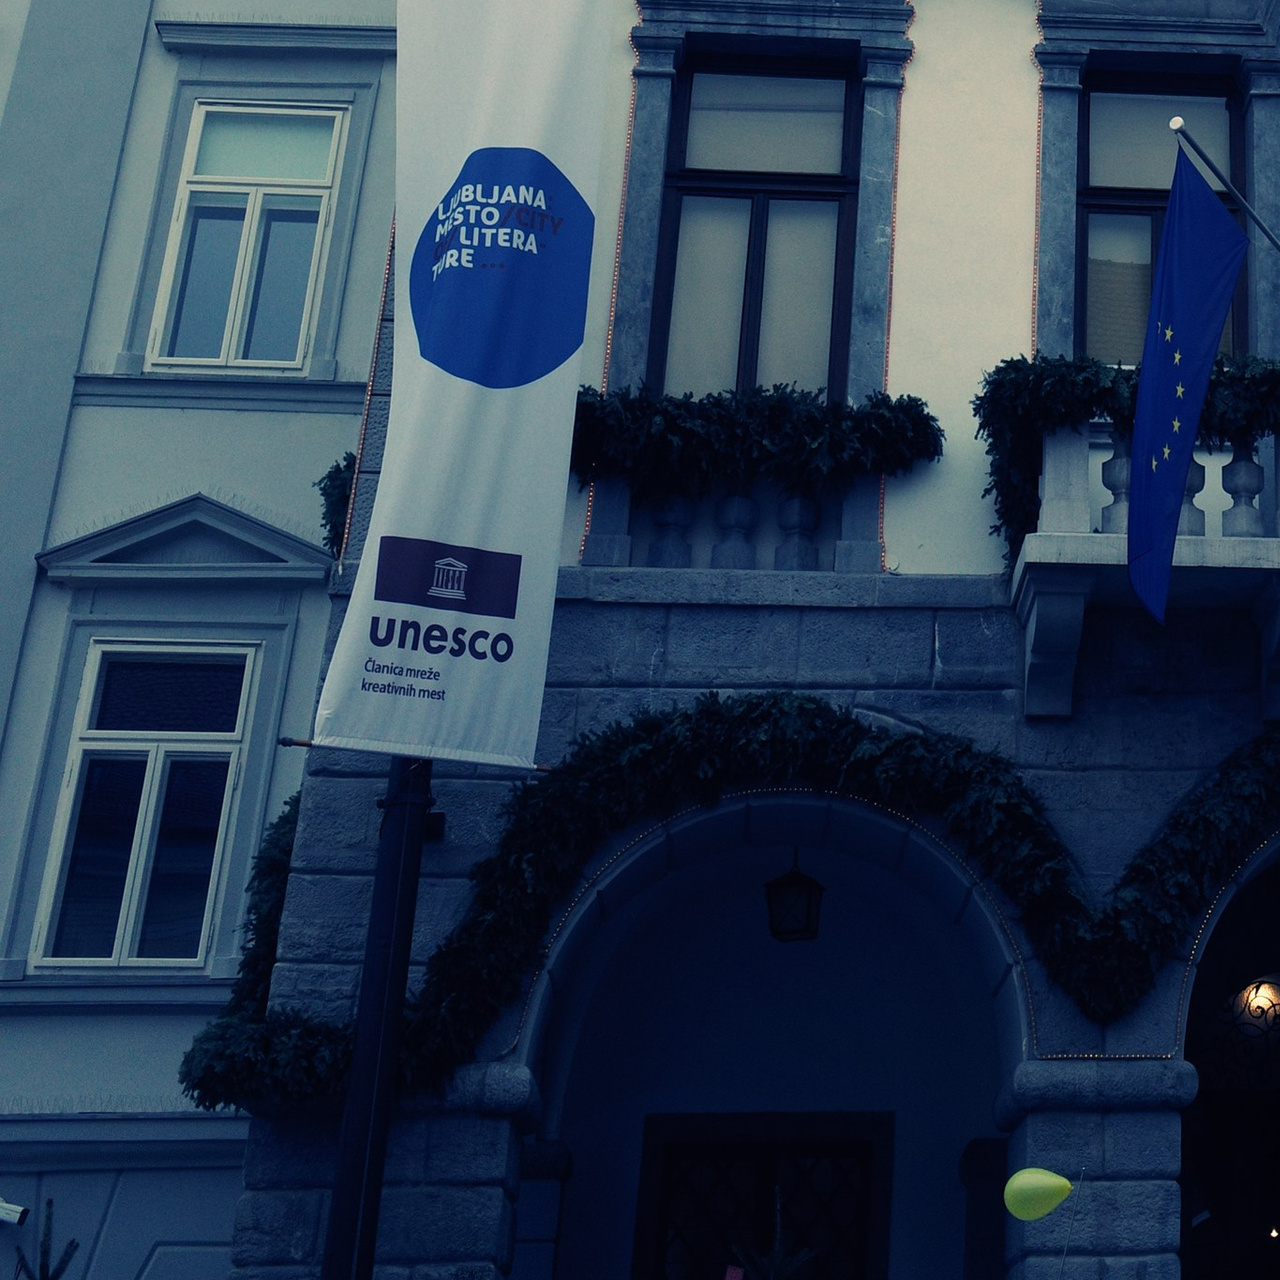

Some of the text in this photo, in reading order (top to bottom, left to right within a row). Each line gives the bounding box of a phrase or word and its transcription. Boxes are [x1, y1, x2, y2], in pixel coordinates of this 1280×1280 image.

[369, 616, 514, 663] unesco
[364, 657, 441, 681] Članica mreže
[361, 678, 446, 701] kreativnih mest
